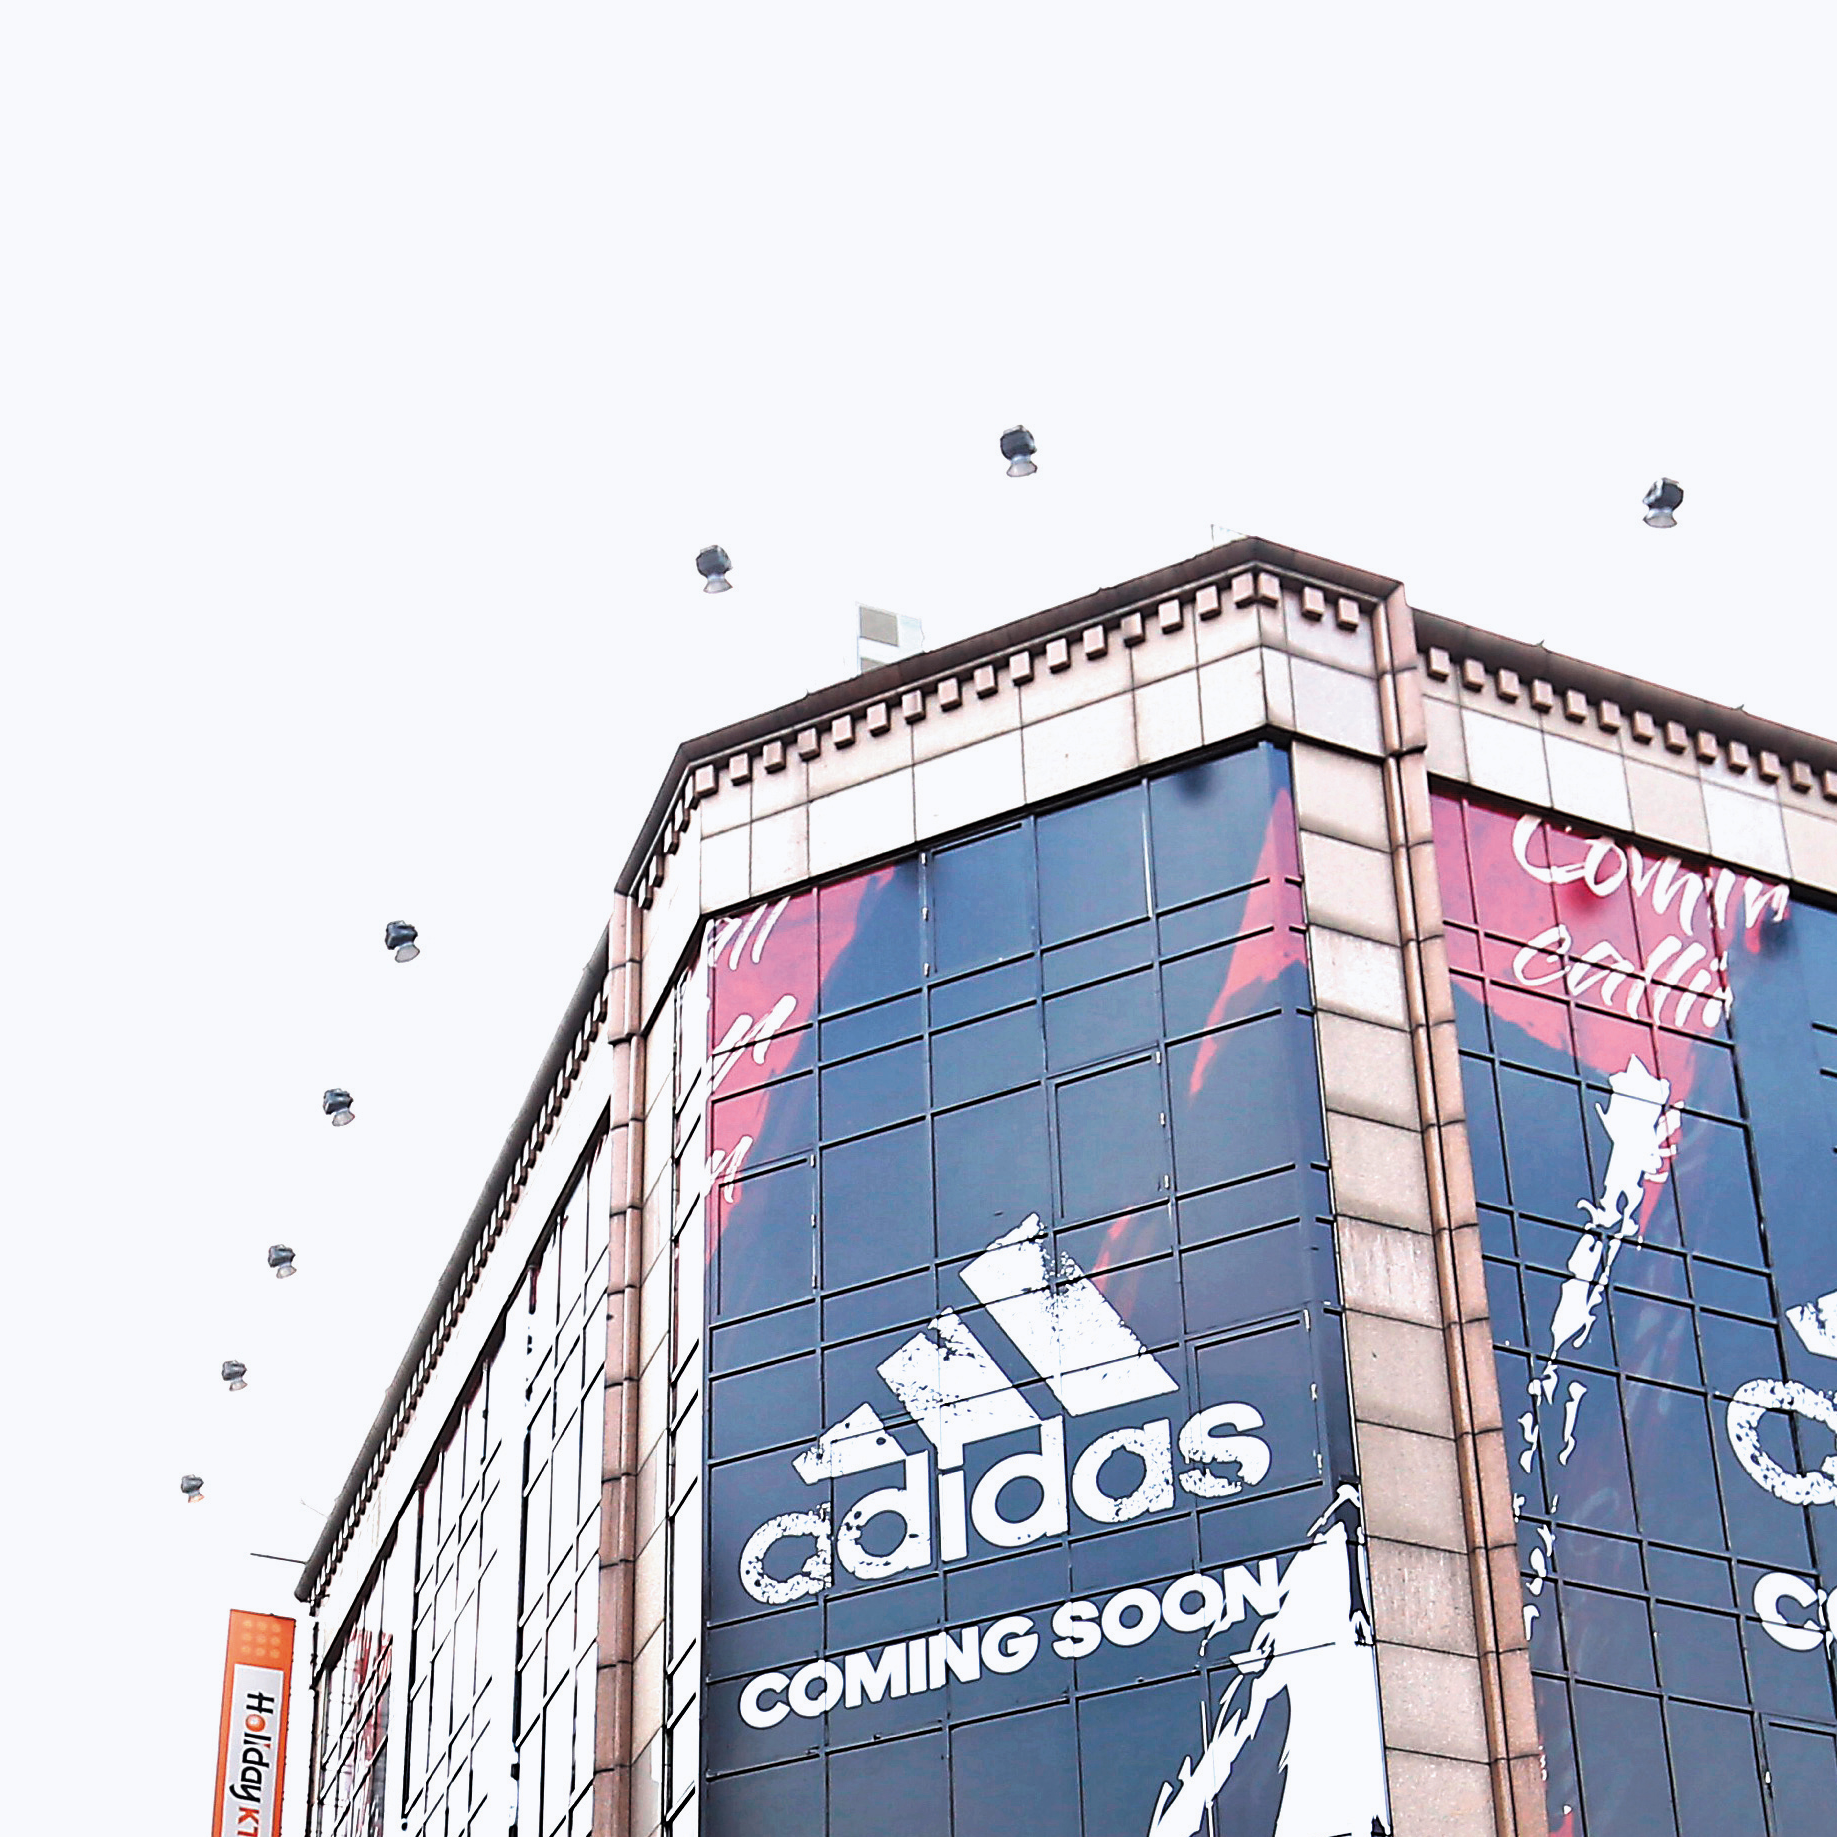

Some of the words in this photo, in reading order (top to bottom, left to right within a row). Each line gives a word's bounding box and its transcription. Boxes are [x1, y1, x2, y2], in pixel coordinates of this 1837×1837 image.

[739, 1402, 1273, 1605] adidas
[739, 1614, 1040, 1729] COMING
[1052, 1556, 1287, 1661] SOON
[229, 1689, 276, 1808] Holiday
